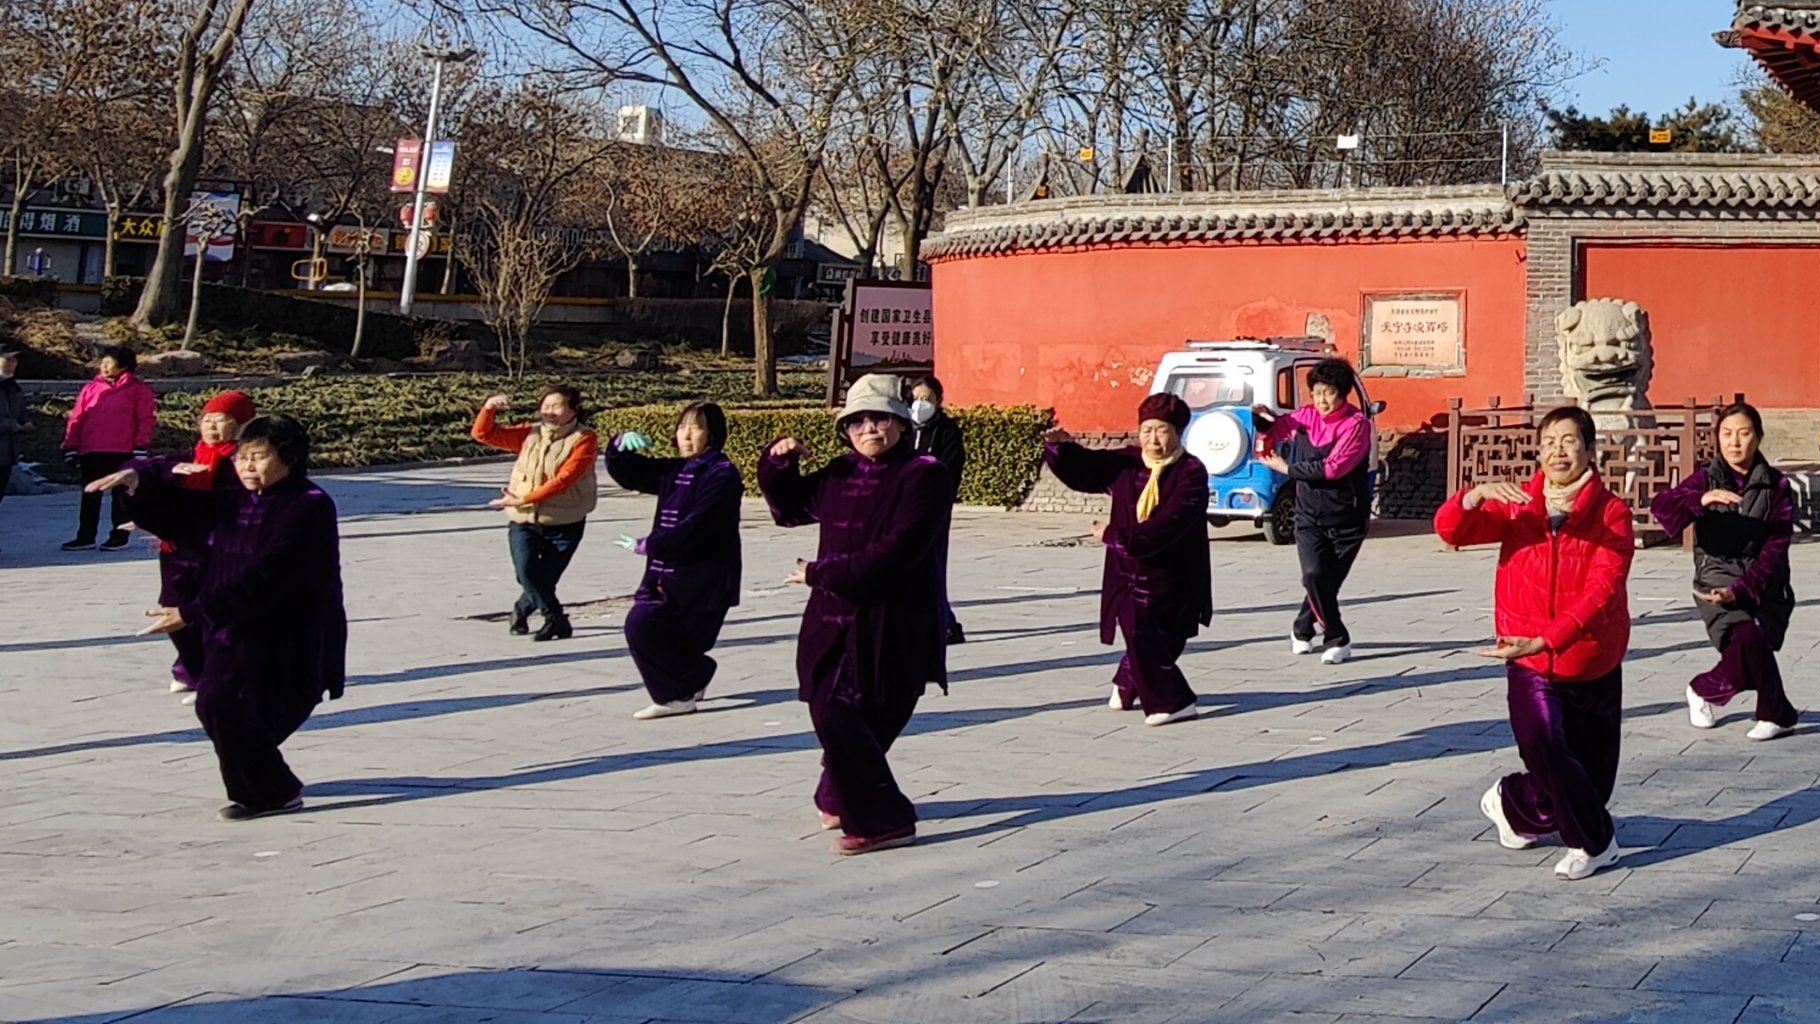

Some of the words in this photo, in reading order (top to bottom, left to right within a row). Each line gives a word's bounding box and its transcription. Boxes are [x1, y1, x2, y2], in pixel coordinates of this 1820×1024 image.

[860, 308, 931, 324] 创建国家卫生县
[870, 331, 931, 346] 享受健康美好
